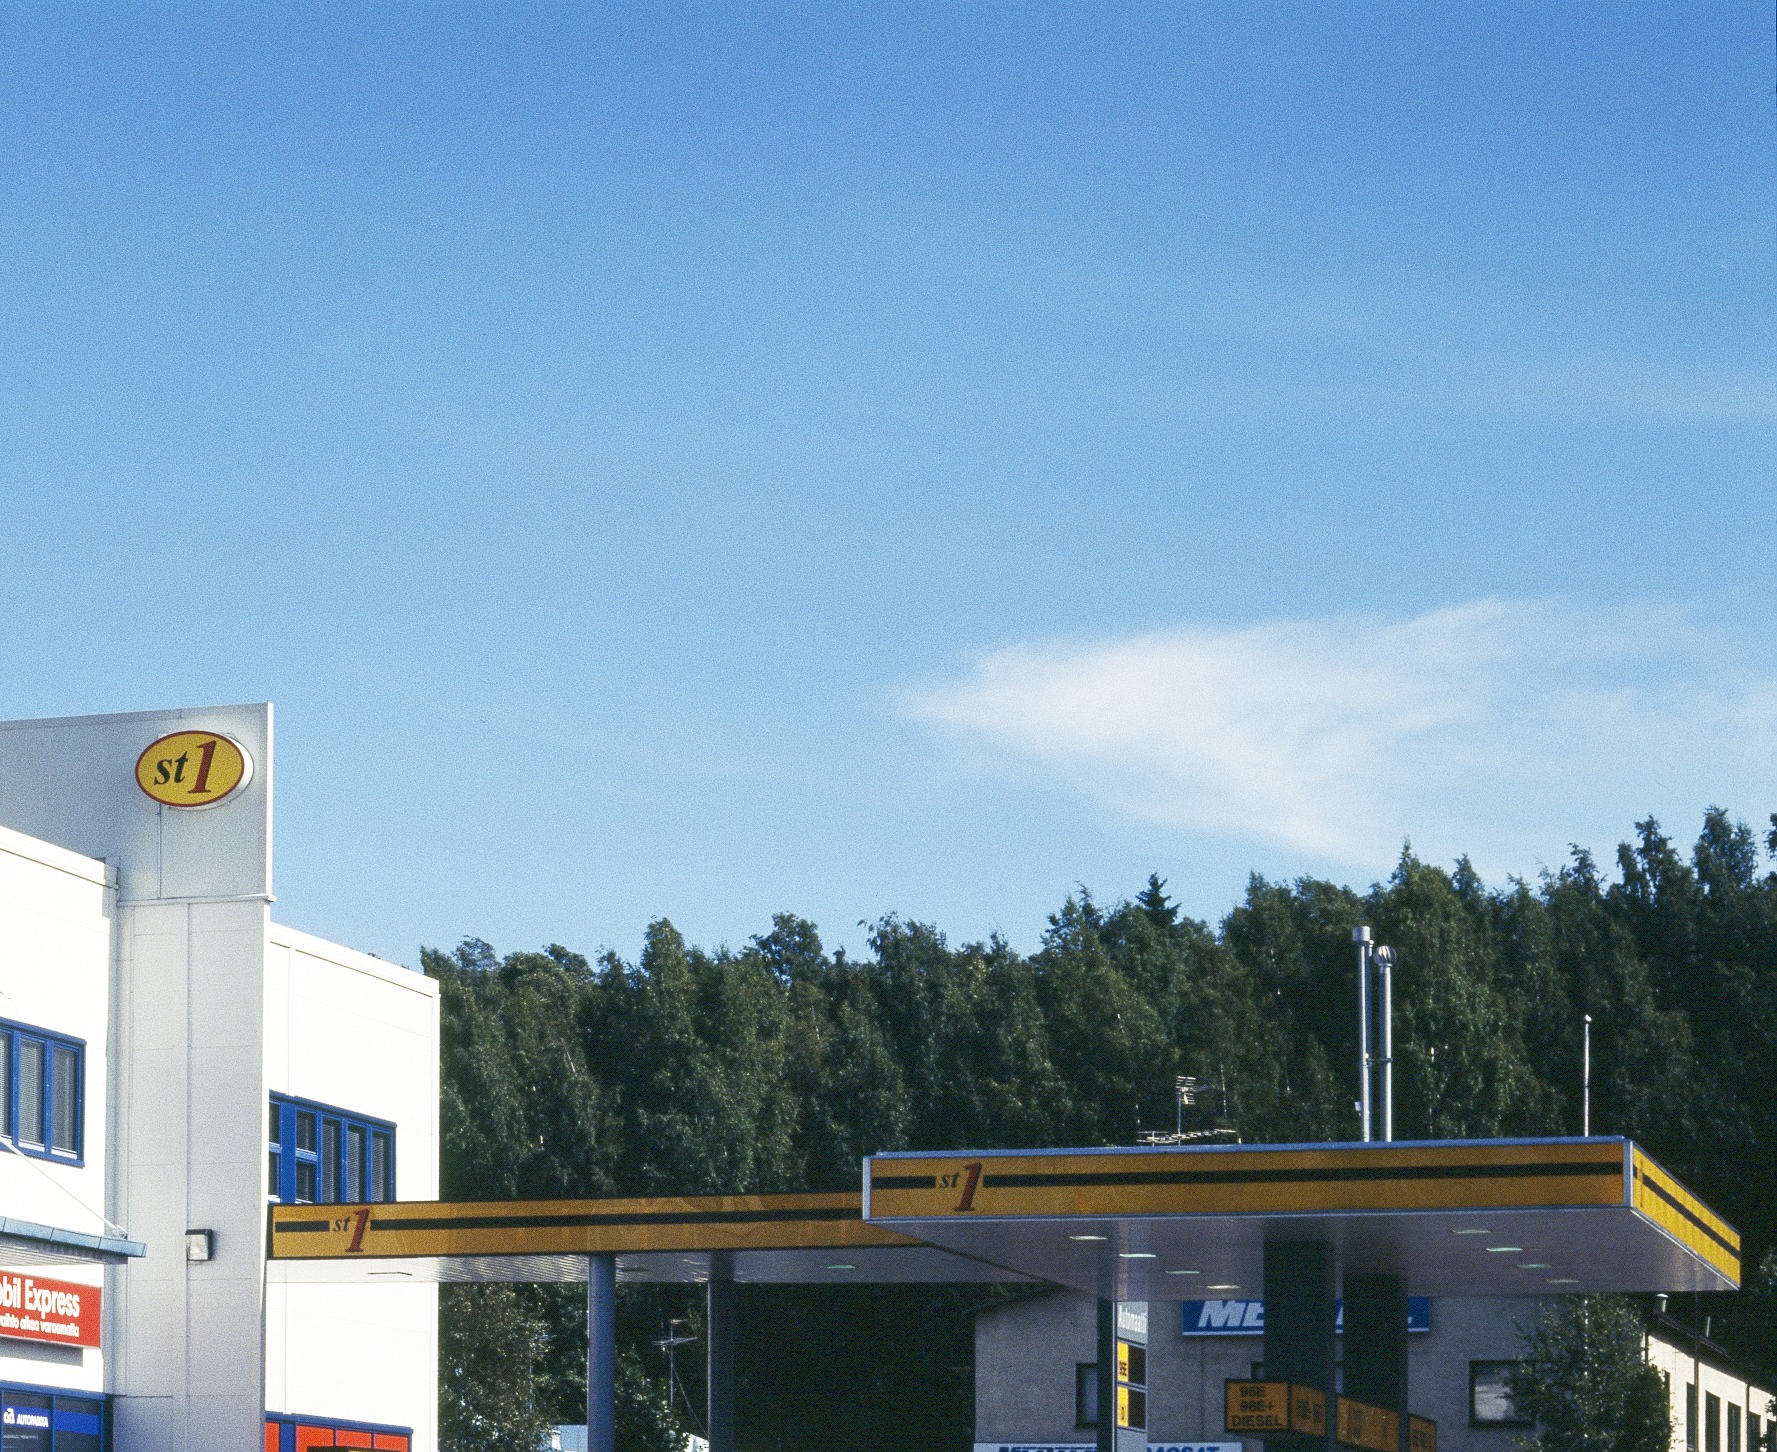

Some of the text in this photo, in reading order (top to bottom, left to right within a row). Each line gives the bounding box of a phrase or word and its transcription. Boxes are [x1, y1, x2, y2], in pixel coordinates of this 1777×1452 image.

[153, 740, 218, 794] st1
[938, 1162, 984, 1212] st1
[332, 1208, 371, 1253] st1
[25, 1279, 80, 1319] Express
[1231, 1415, 1283, 1427] DIESEL
